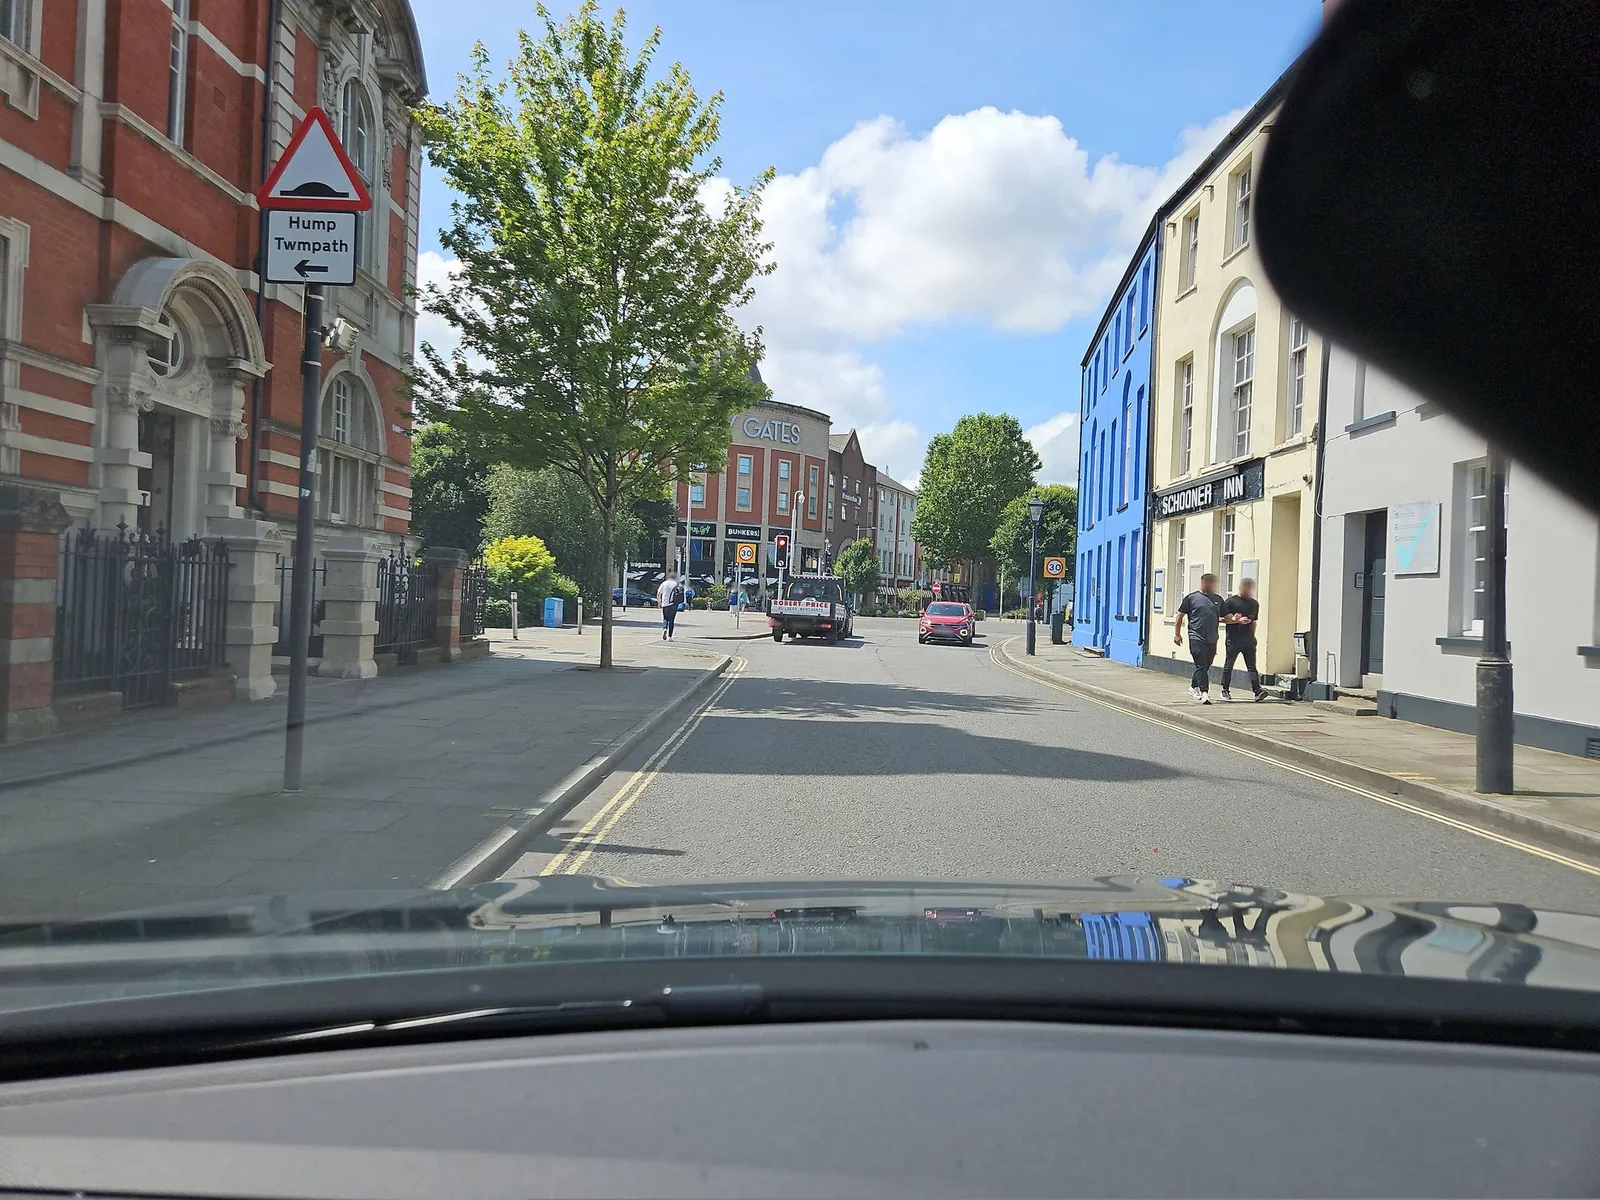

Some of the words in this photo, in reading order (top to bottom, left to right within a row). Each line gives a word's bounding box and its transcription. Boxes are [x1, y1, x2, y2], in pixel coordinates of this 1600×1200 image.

[289, 216, 336, 232] Hump
[274, 237, 348, 254] Twmpath
[742, 416, 801, 445] GATES
[1162, 483, 1212, 514] SCHOONER
[1223, 474, 1244, 499] INN
[728, 528, 760, 537] BUNKERS!
[741, 549, 752, 557] 30
[1048, 563, 1062, 572] 30
